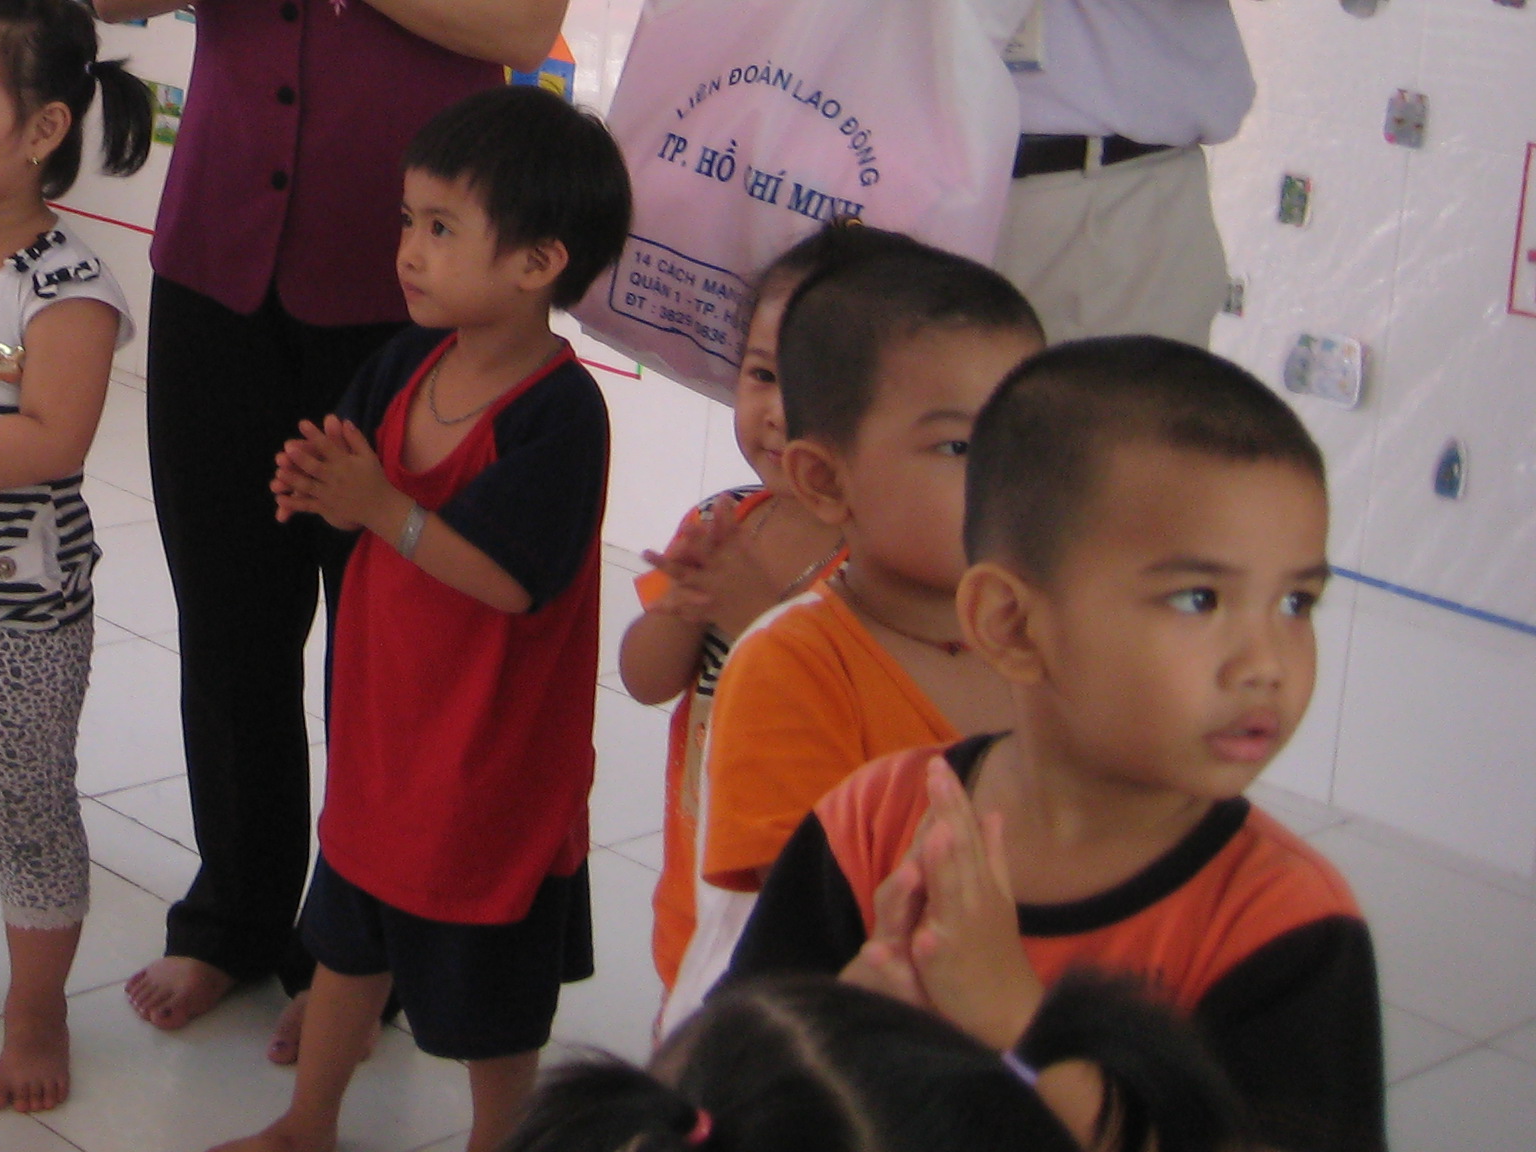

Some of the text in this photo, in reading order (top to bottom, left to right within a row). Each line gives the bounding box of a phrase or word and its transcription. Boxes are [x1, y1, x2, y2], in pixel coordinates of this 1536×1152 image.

[728, 59, 793, 91] ĐOÀN
[792, 79, 841, 119] LAO
[839, 116, 880, 187] ĐỘNG
[657, 131, 688, 167] TP.
[694, 138, 739, 183] HỒ
[635, 251, 652, 266] 14
